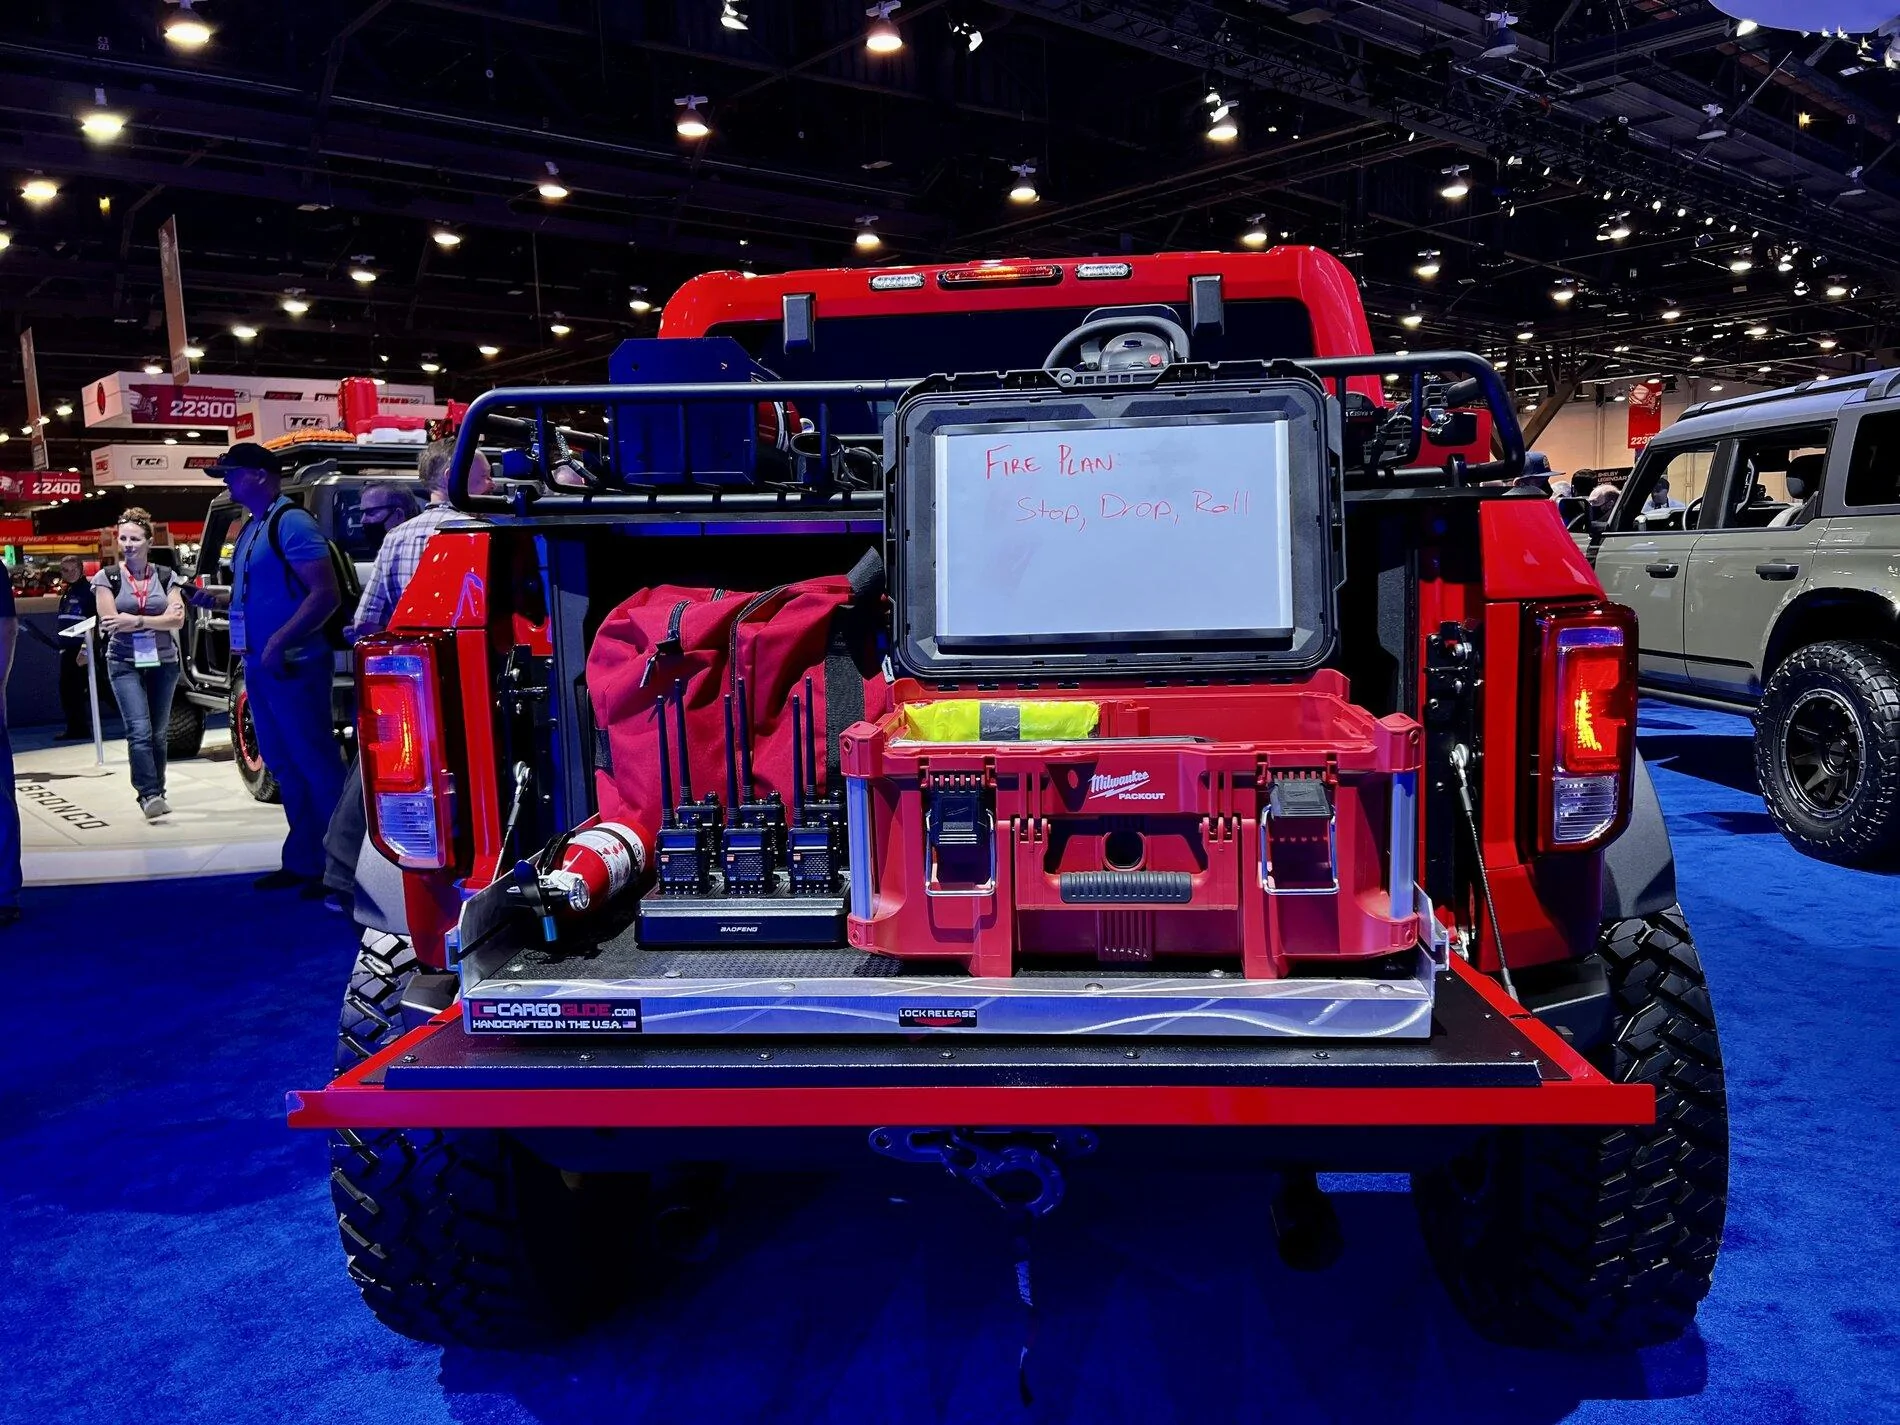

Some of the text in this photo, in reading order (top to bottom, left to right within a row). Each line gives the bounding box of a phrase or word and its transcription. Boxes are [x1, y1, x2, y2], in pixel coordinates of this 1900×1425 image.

[169, 400, 236, 418] 22300
[32, 482, 81, 495] 22400
[1015, 489, 1250, 532] Stop, Drop, Roll
[1088, 769, 1150, 794] Milwaukee
[1118, 792, 1166, 800] PACKOUT
[16, 784, 111, 830] BRONCO
[899, 1009, 977, 1018] LOCK RELEASE
[472, 1020, 623, 1030] HANDCRAFTED IN THE U.S.A.
